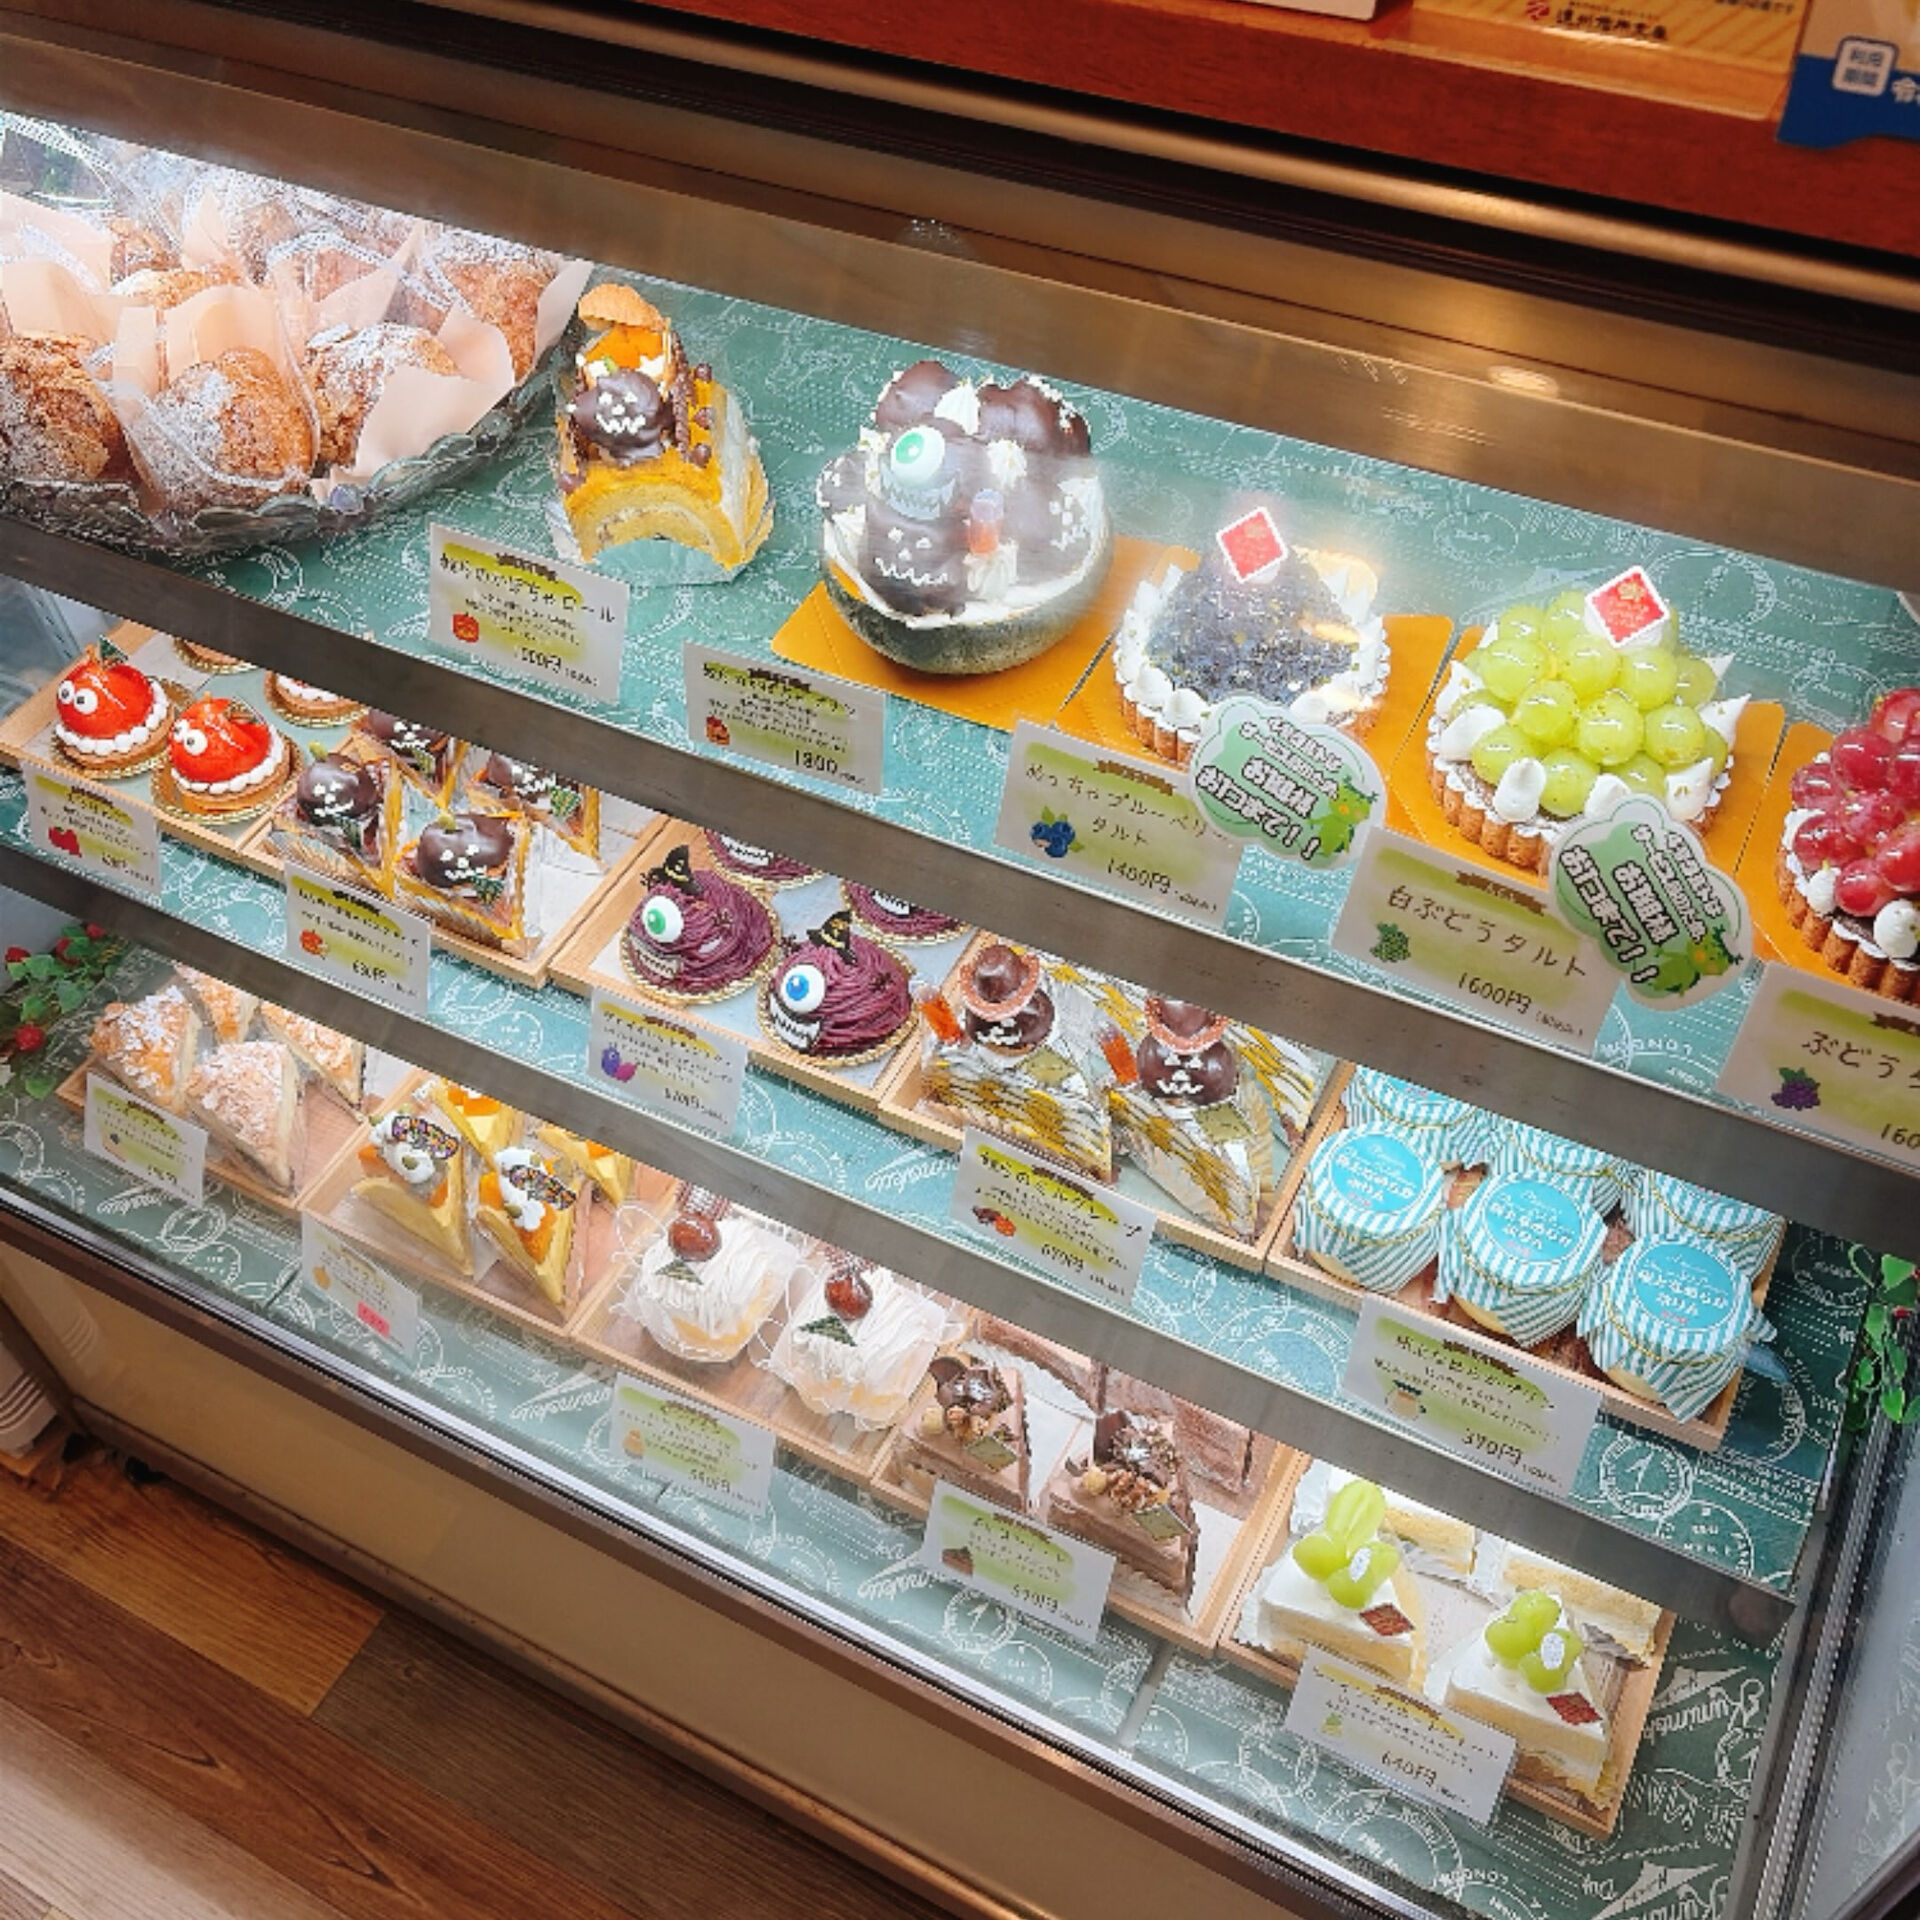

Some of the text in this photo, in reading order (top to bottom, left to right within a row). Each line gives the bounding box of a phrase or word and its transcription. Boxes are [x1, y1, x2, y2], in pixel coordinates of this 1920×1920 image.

[1091, 814, 1149, 850] タルト
[1385, 881, 1591, 982] 白ぶどうタルト
[1456, 969, 1532, 1017] 1600円
